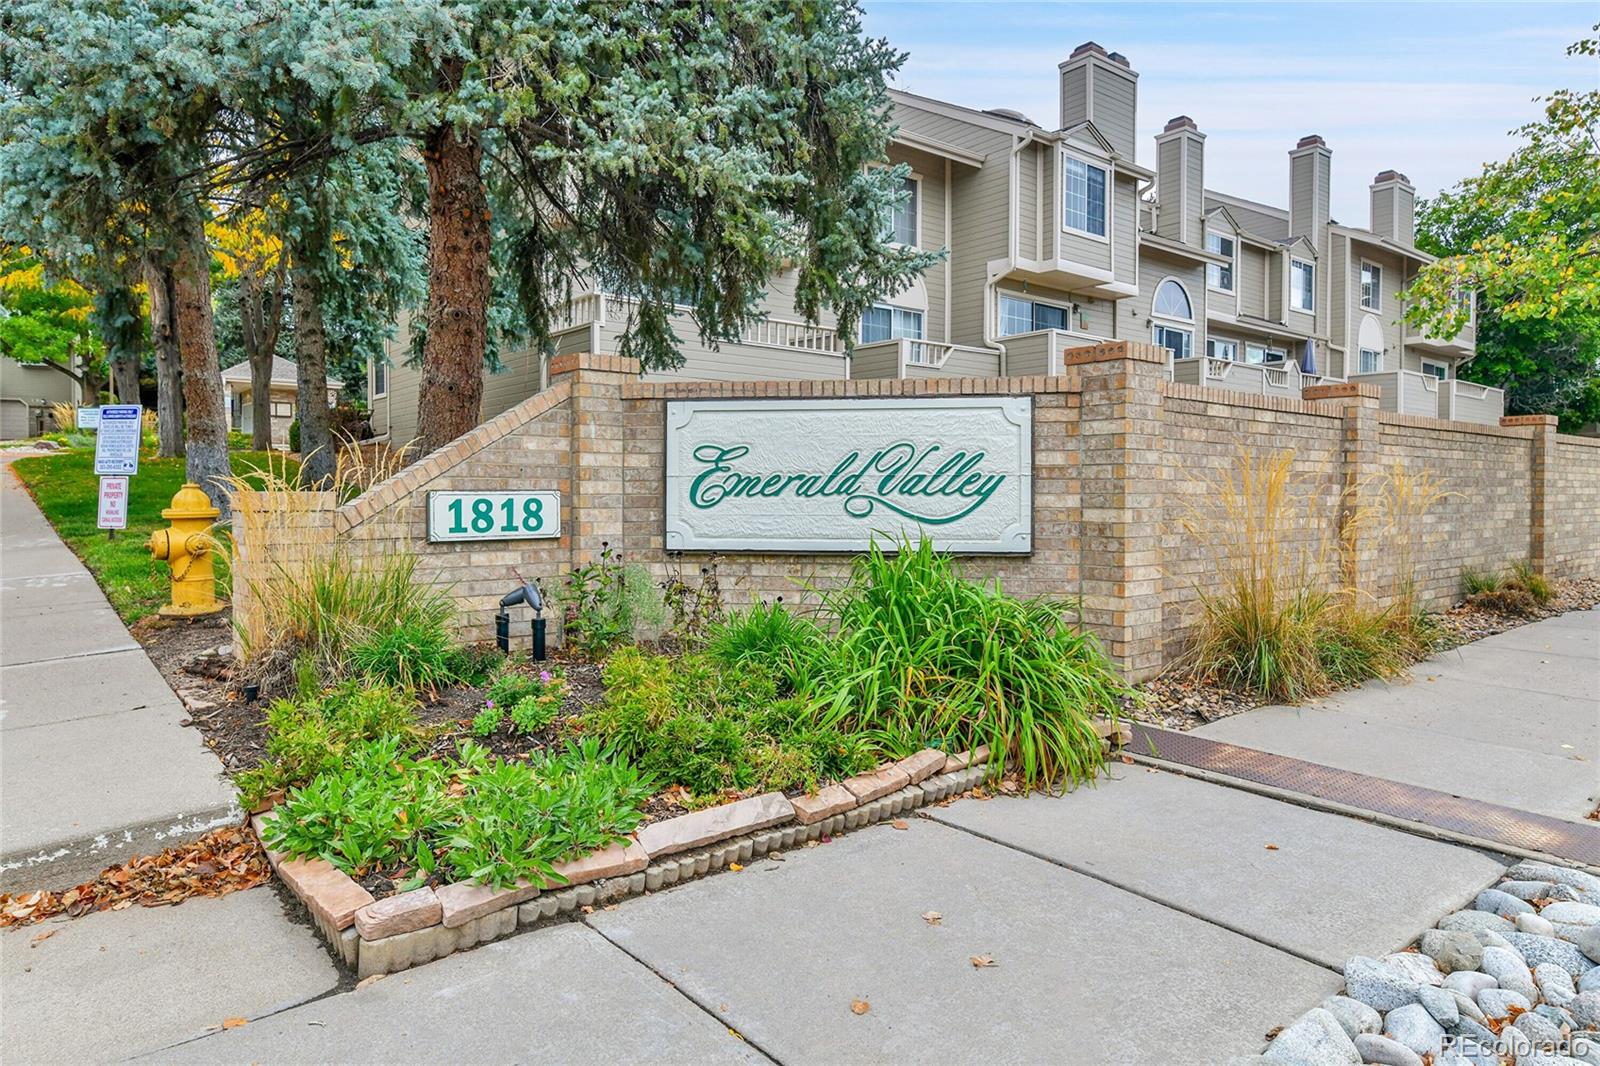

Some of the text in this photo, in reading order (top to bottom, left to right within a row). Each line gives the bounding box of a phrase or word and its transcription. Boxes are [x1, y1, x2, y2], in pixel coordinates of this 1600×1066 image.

[103, 491, 123, 499] PROPERTY
[689, 442, 1006, 525] Emerald Valley
[448, 497, 544, 534] 1818
